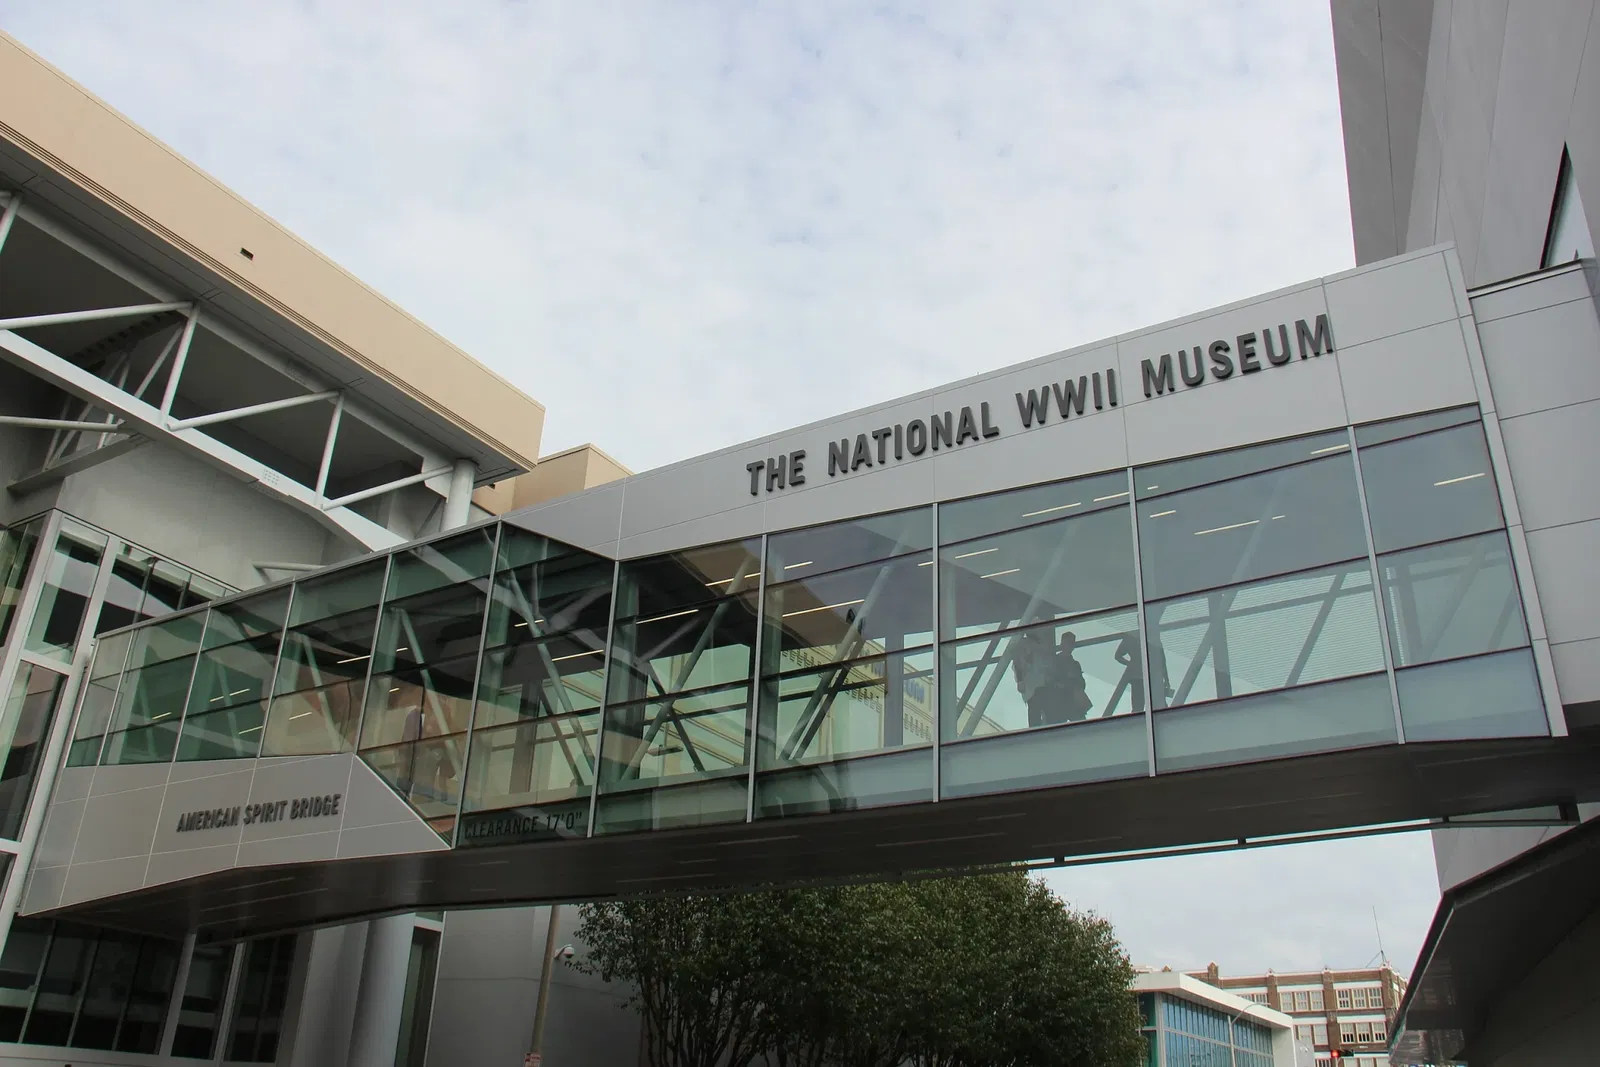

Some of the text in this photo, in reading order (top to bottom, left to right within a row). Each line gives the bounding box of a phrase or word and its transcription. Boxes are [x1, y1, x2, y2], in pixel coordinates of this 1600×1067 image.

[746, 313, 1334, 496] THE NATIONAL WWII MUSEUM
[176, 793, 342, 832] AMERICAN SPIRIT BRIDGE
[464, 815, 539, 838] CLEARANCE
